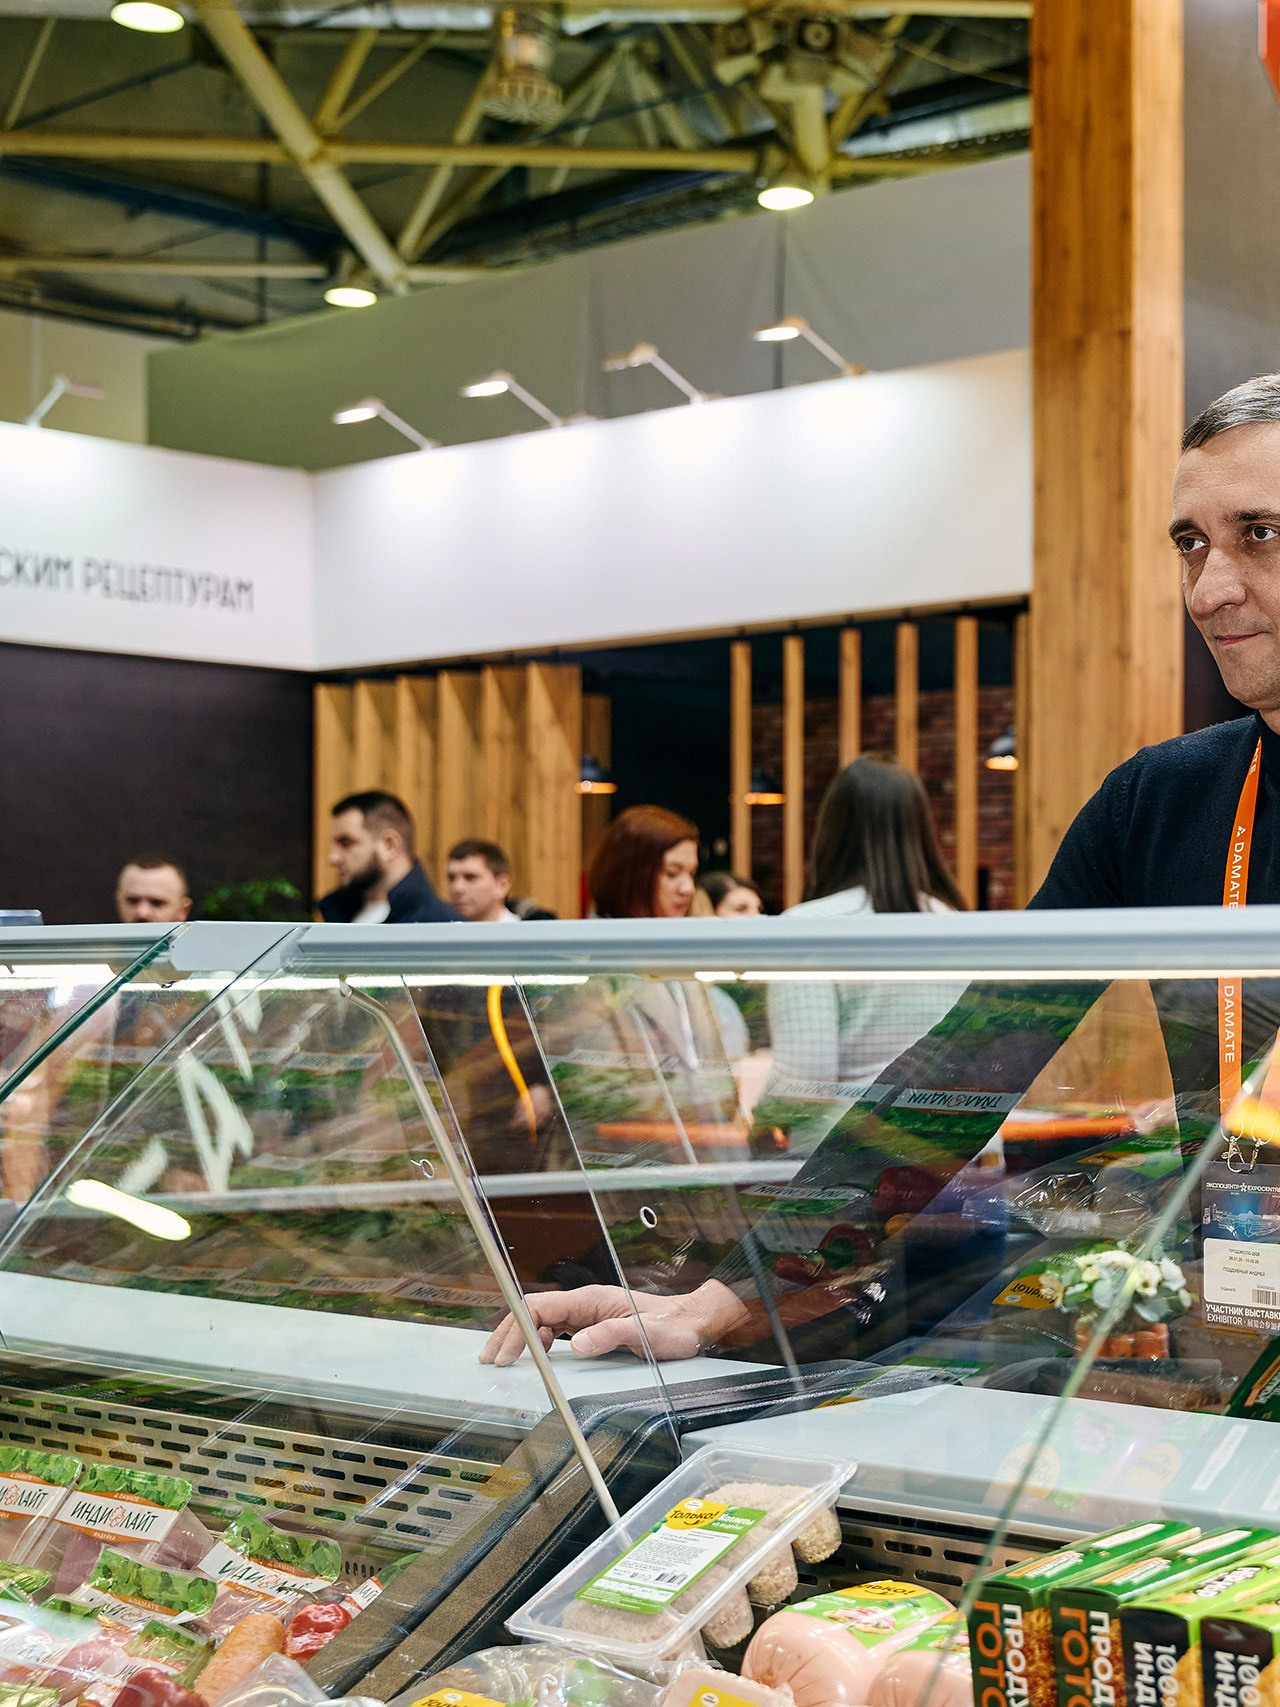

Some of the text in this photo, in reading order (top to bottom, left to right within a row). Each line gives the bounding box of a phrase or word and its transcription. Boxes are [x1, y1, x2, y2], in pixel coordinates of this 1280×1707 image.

[83, 556, 256, 613] РЕЦЕПТУРАМ
[1228, 841, 1245, 909] DAMATE
[1223, 985, 1236, 1064] DAMATE
[1205, 1303, 1245, 1317] УЧАСТНИК
[1206, 1313, 1243, 1326] EXHIBITOR
[668, 1509, 721, 1520] Только!
